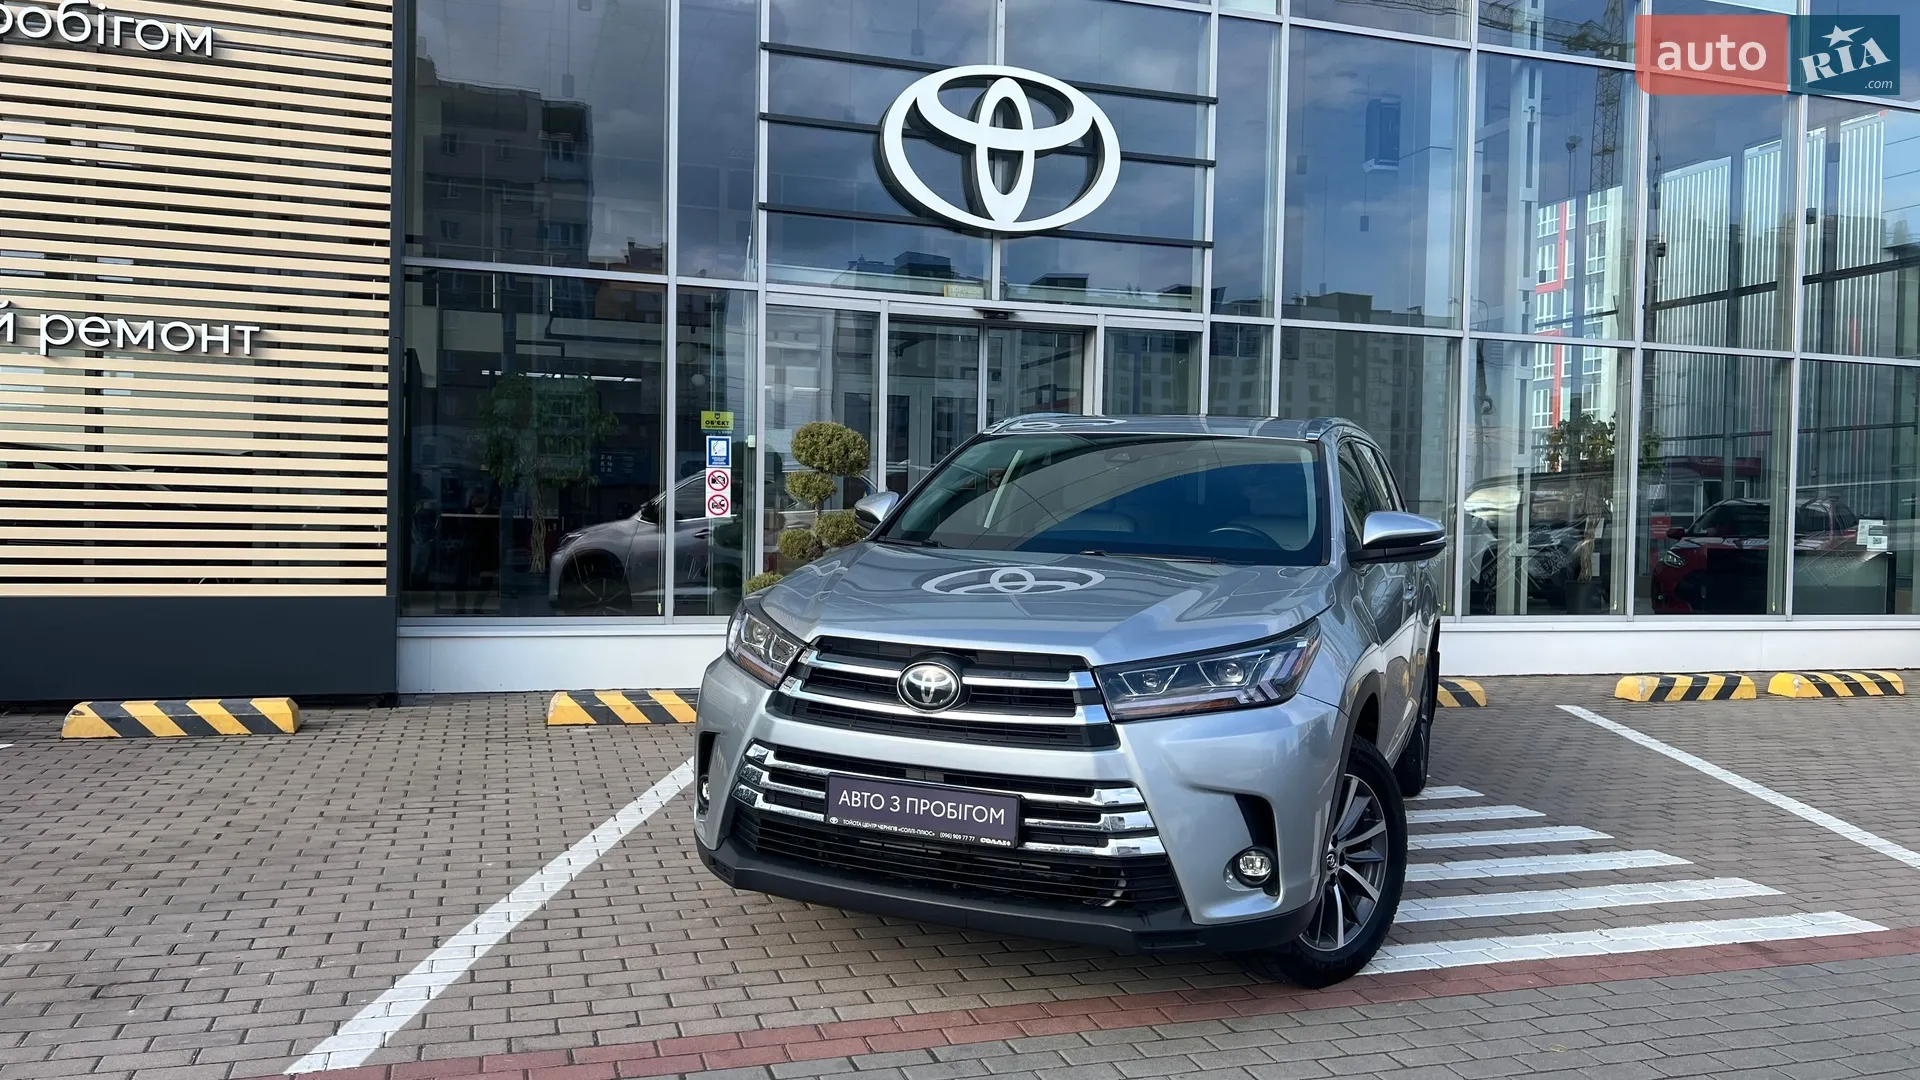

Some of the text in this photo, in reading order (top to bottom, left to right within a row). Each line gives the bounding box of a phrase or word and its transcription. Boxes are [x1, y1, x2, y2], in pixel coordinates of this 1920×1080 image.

[40, 313, 260, 357] ремонт
[838, 789, 1005, 825] АВТО З ПРОБІГОМ
[842, 819, 862, 827] ТОЙОТА
